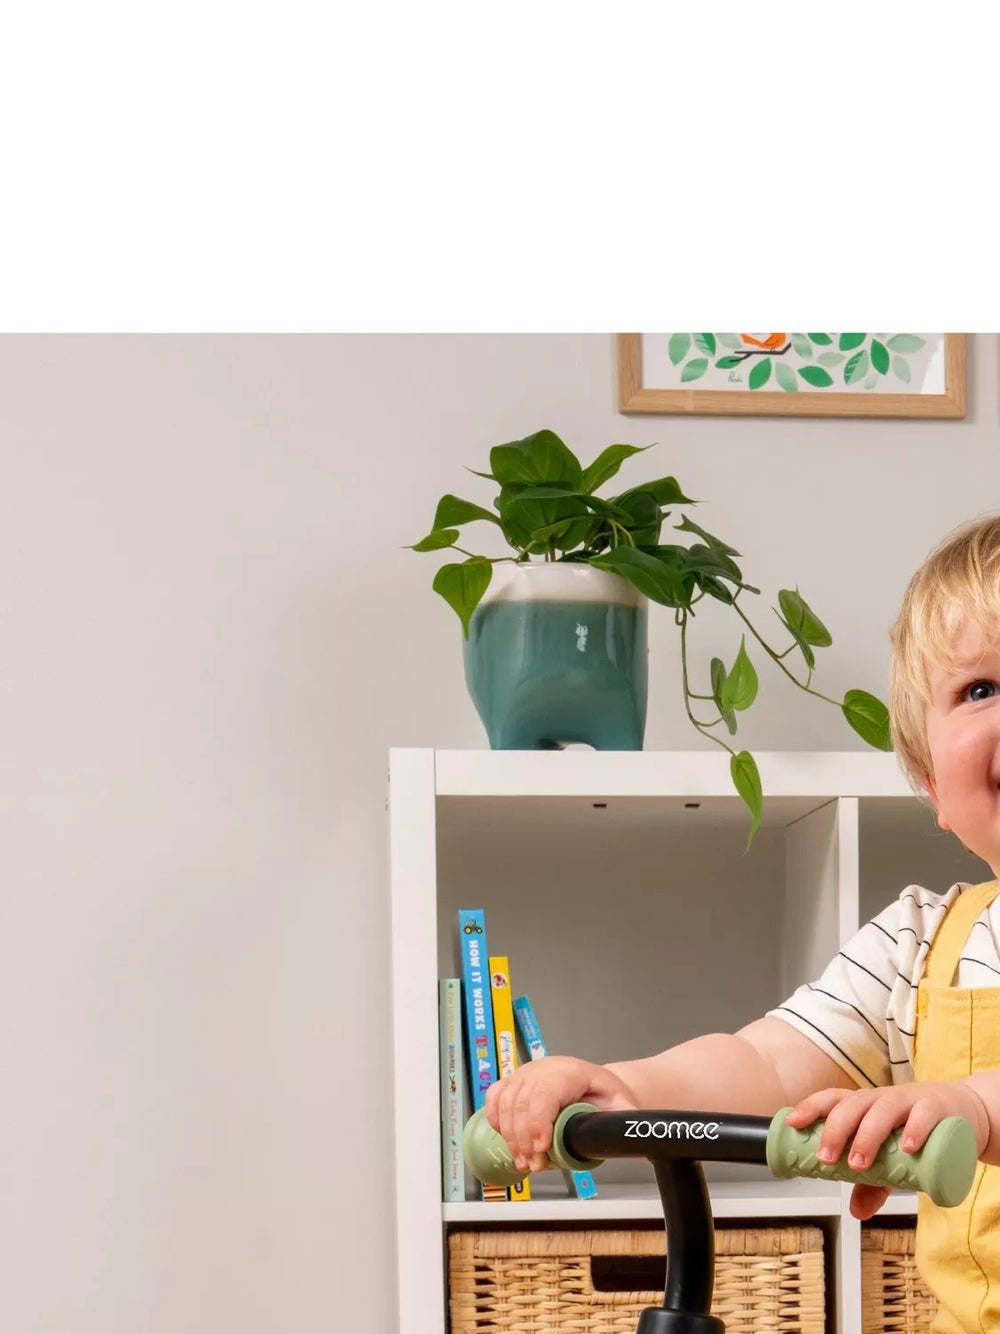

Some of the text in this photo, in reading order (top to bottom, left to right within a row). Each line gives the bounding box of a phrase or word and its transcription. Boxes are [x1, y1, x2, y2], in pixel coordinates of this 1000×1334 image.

[468, 940, 481, 967] HOW
[471, 971, 482, 984] IT
[473, 988, 486, 1030] WORKS
[624, 1120, 720, 1140] zoomee
